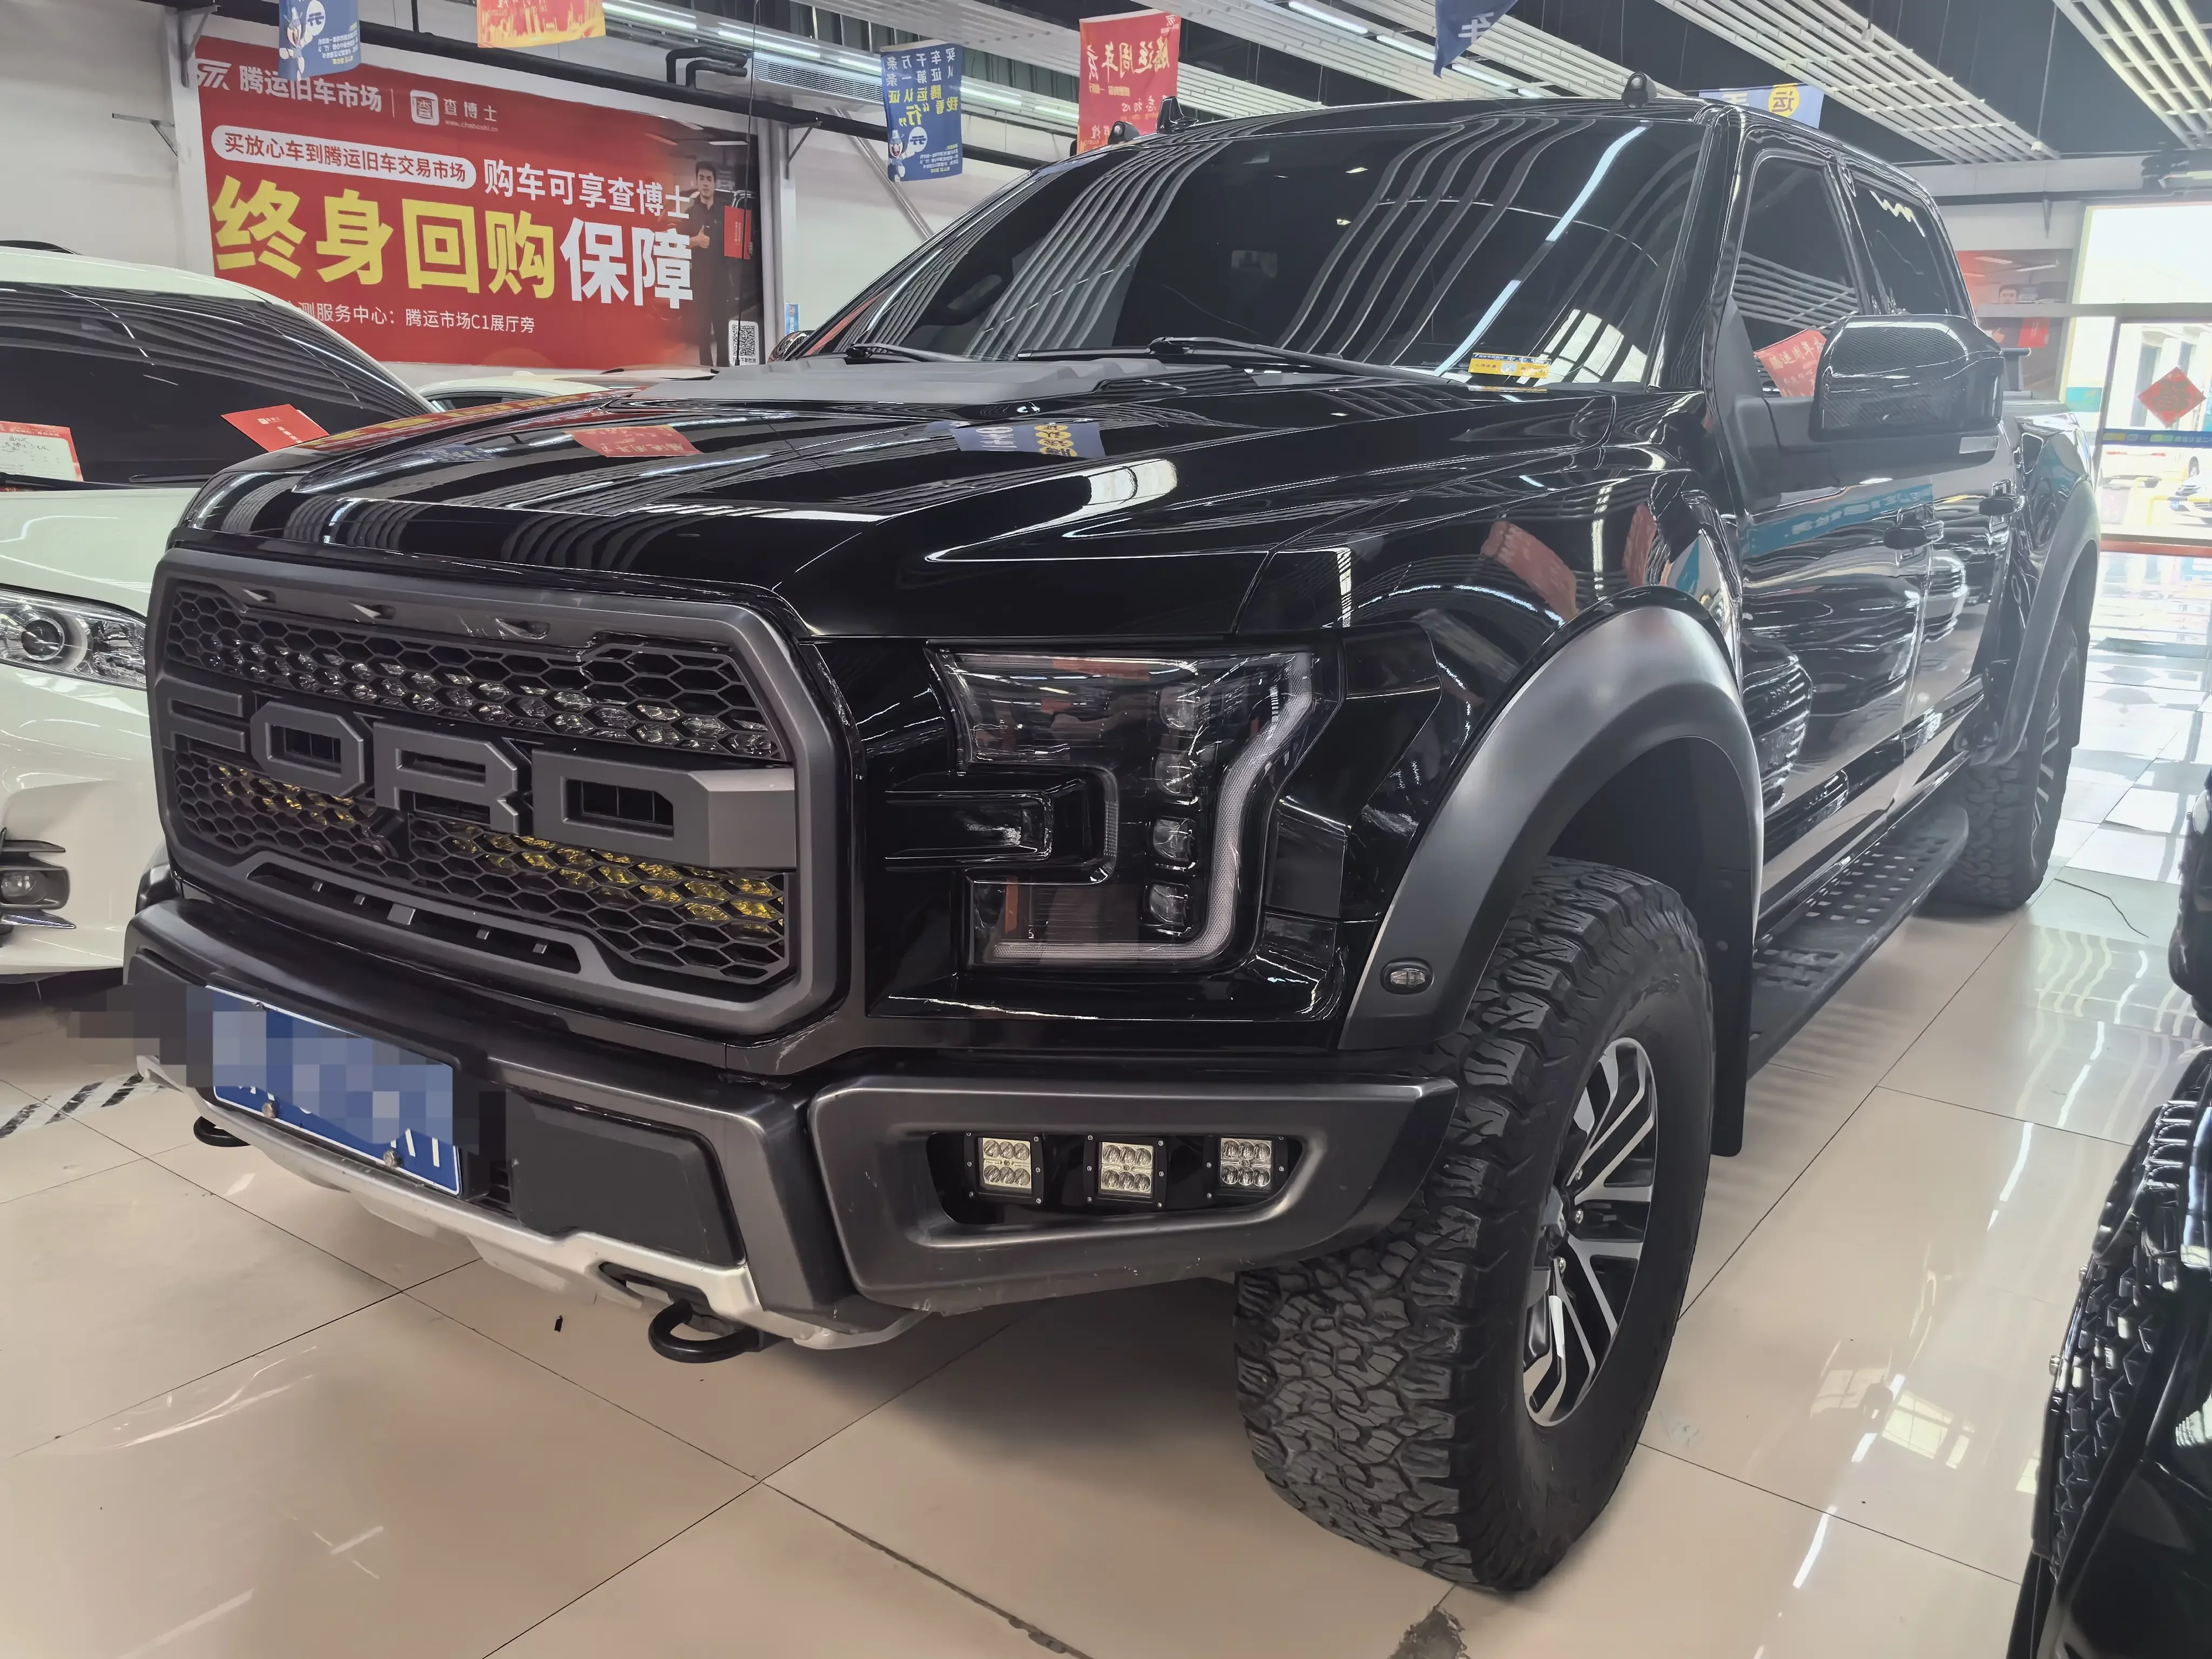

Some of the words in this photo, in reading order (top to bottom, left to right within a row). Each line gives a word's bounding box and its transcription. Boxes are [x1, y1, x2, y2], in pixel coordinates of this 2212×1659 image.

[239, 65, 382, 112] 腾运旧车市场
[443, 97, 497, 122] 查博士
[225, 132, 466, 182] 买放心车到腾运旧车交易市场
[484, 159, 691, 219] 购车可享查博士
[156, 672, 716, 867] FORD
